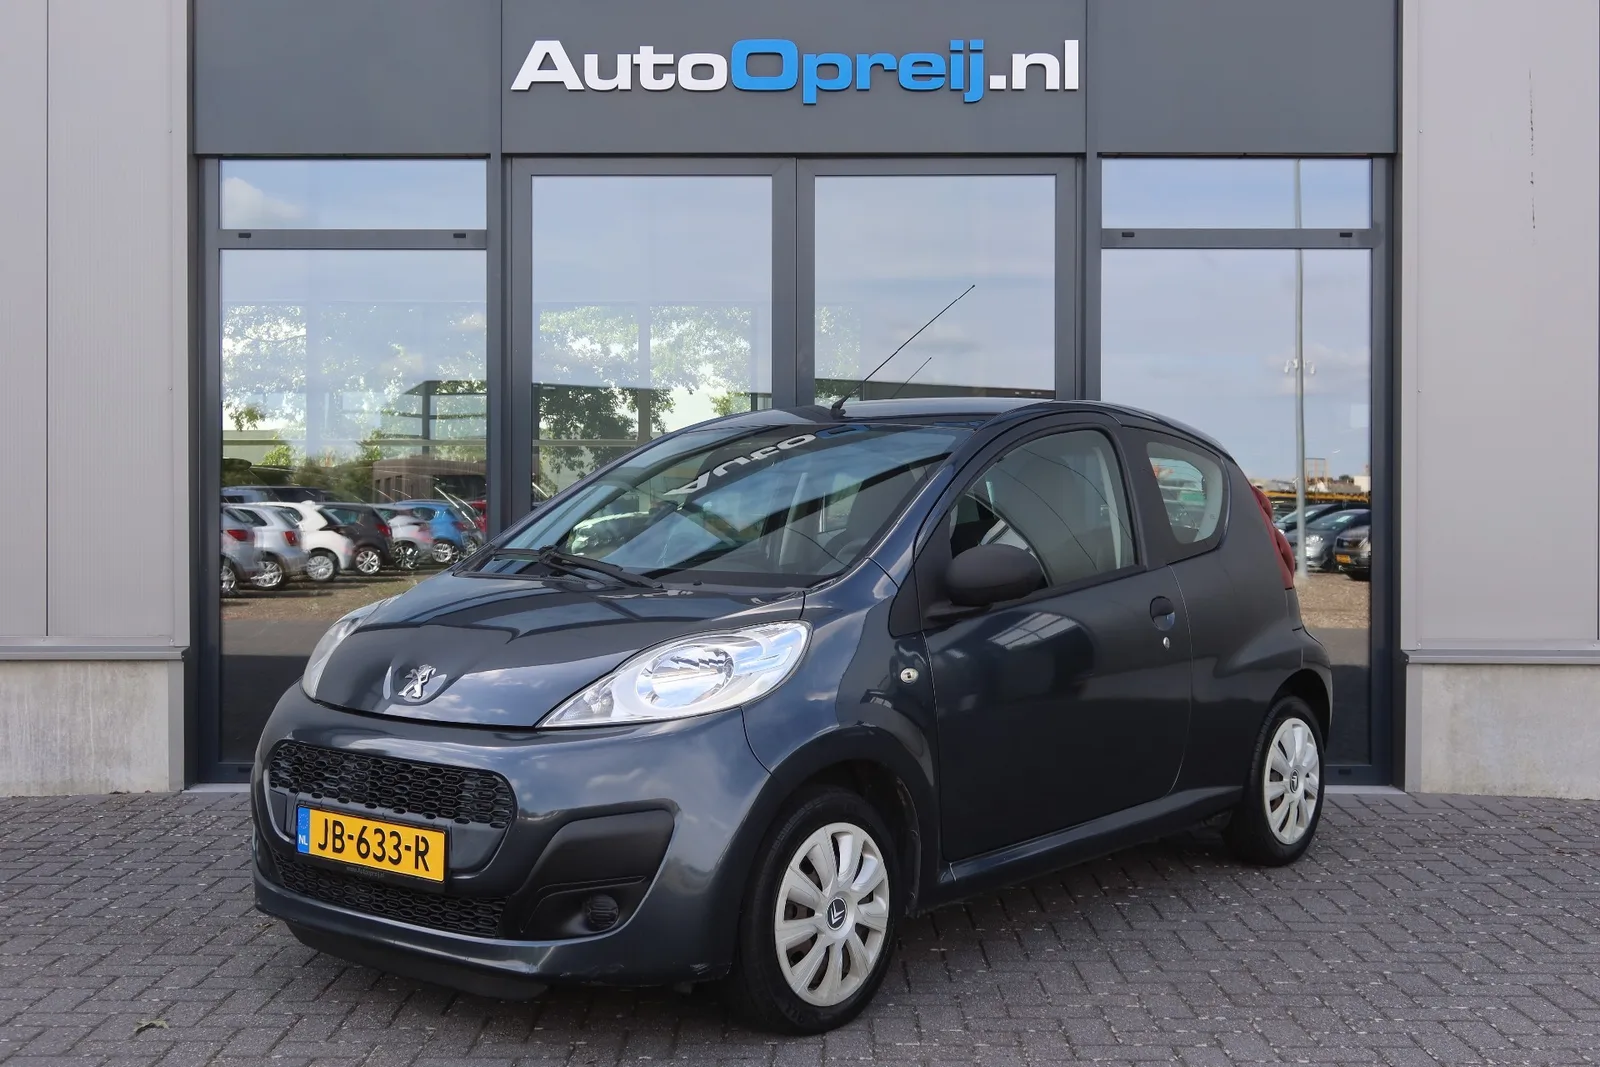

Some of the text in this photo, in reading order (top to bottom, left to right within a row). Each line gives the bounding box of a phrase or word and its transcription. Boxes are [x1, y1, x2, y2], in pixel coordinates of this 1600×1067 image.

[510, 38, 1080, 104] AutoOpreij.nl
[298, 833, 309, 847] NL
[317, 817, 430, 872] JB-633-R
